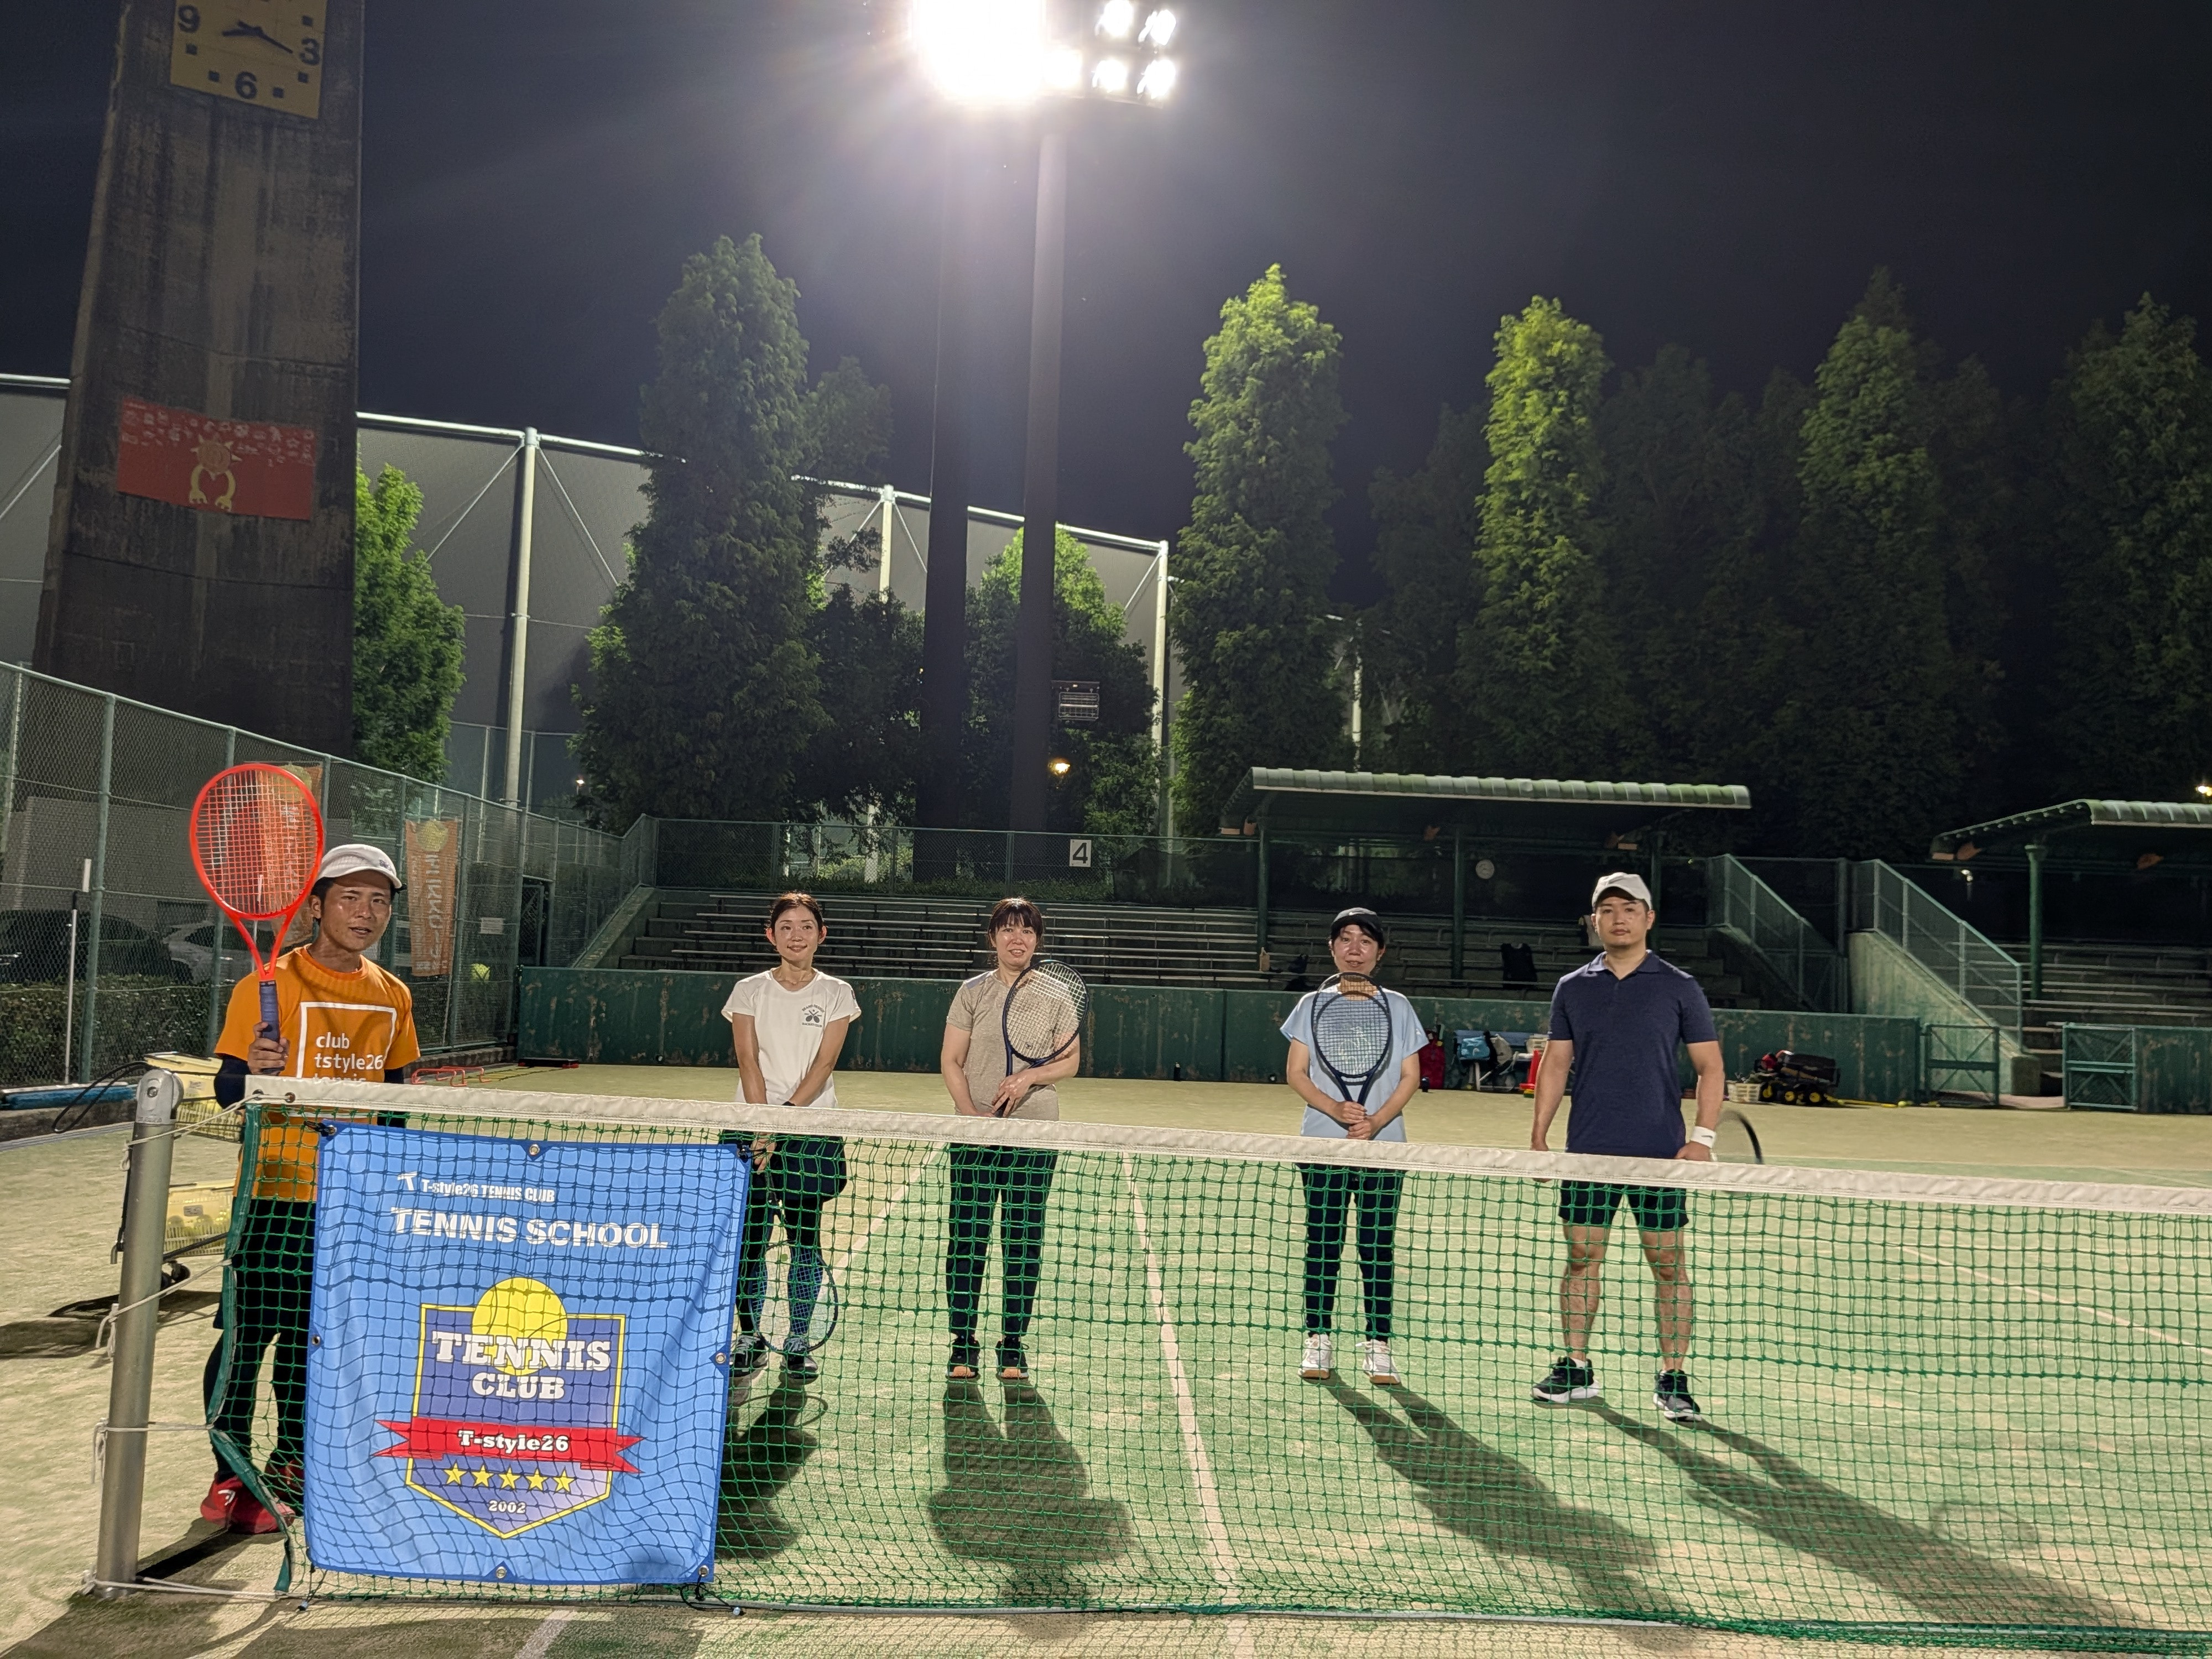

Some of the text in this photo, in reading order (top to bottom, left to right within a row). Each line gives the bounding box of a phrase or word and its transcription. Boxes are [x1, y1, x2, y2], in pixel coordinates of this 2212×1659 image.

[178, 5, 200, 33] 9
[299, 38, 320, 66] 3
[235, 71, 258, 100] 6
[1072, 842, 1088, 864] 4
[316, 1031, 349, 1049] club
[314, 1053, 383, 1073] tstyle26
[481, 1185, 523, 1200] TENNIS
[525, 1188, 555, 1202] CLUB
[390, 1207, 668, 1248] TENNIS SCHOOL
[432, 1331, 612, 1371] TENNIS
[472, 1372, 565, 1399] CLUB
[457, 1430, 570, 1454] T-style26
[488, 1500, 526, 1515] 2002
